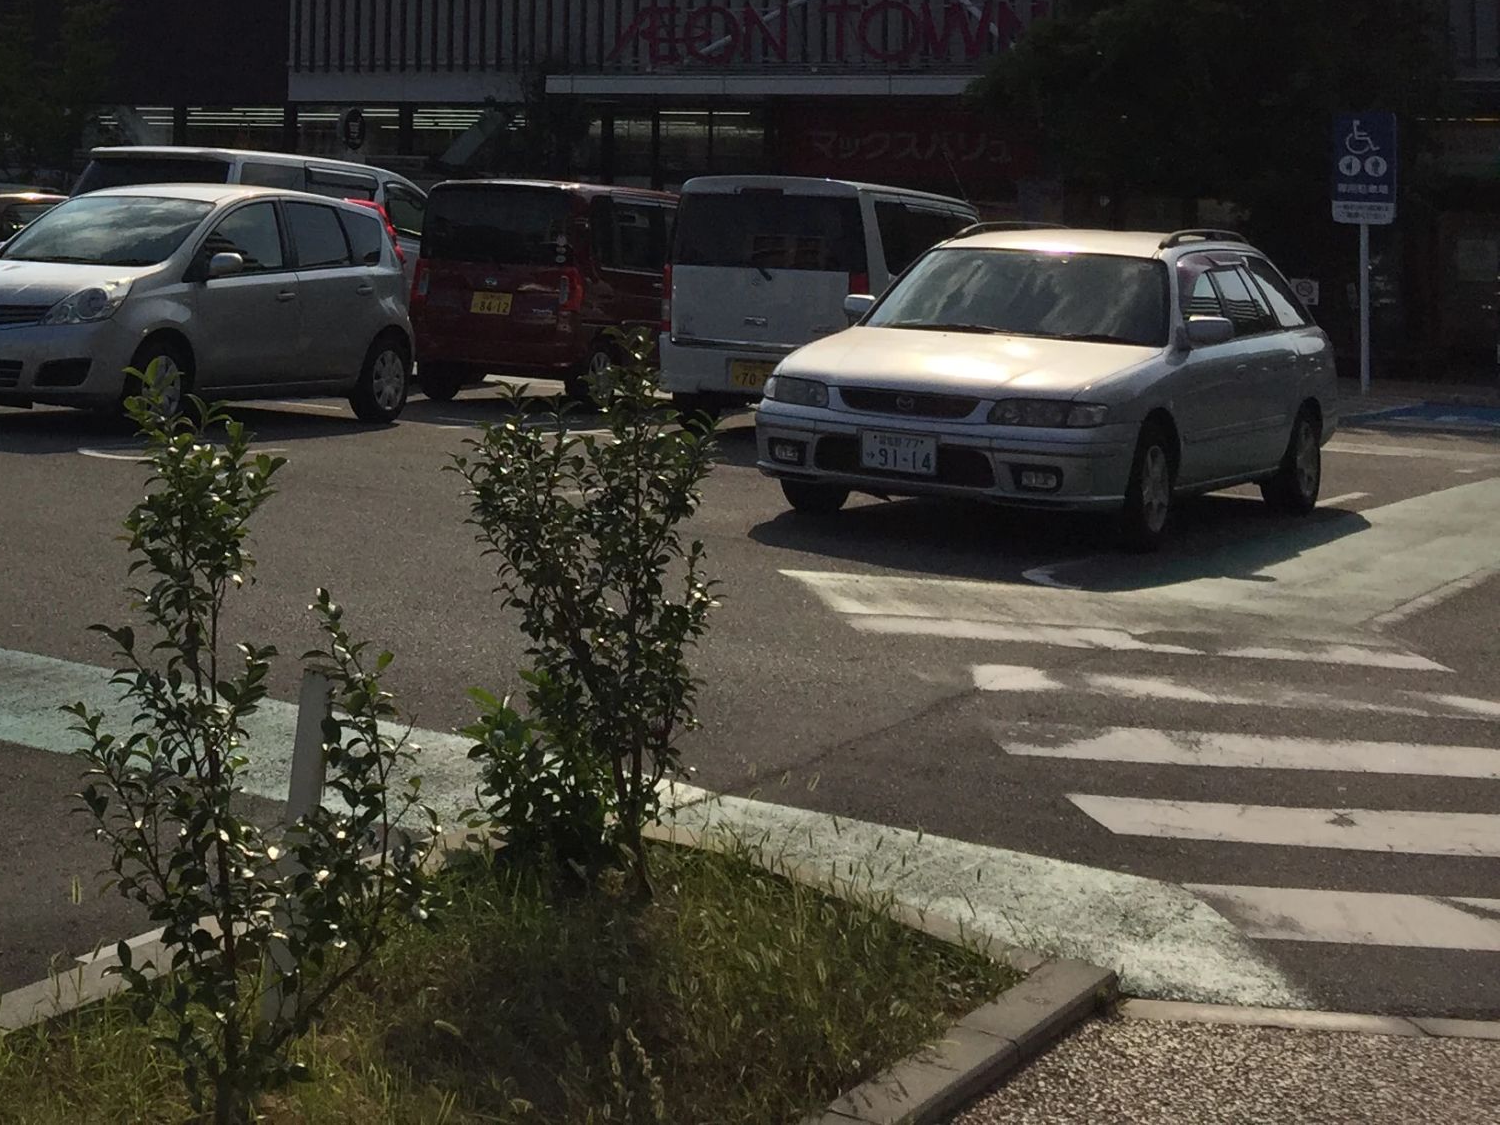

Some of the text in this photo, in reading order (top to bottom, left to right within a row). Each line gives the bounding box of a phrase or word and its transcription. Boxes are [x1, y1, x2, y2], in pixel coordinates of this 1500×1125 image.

[809, 128, 1013, 164] マックスバリュ
[878, 448, 932, 471] 91-14
